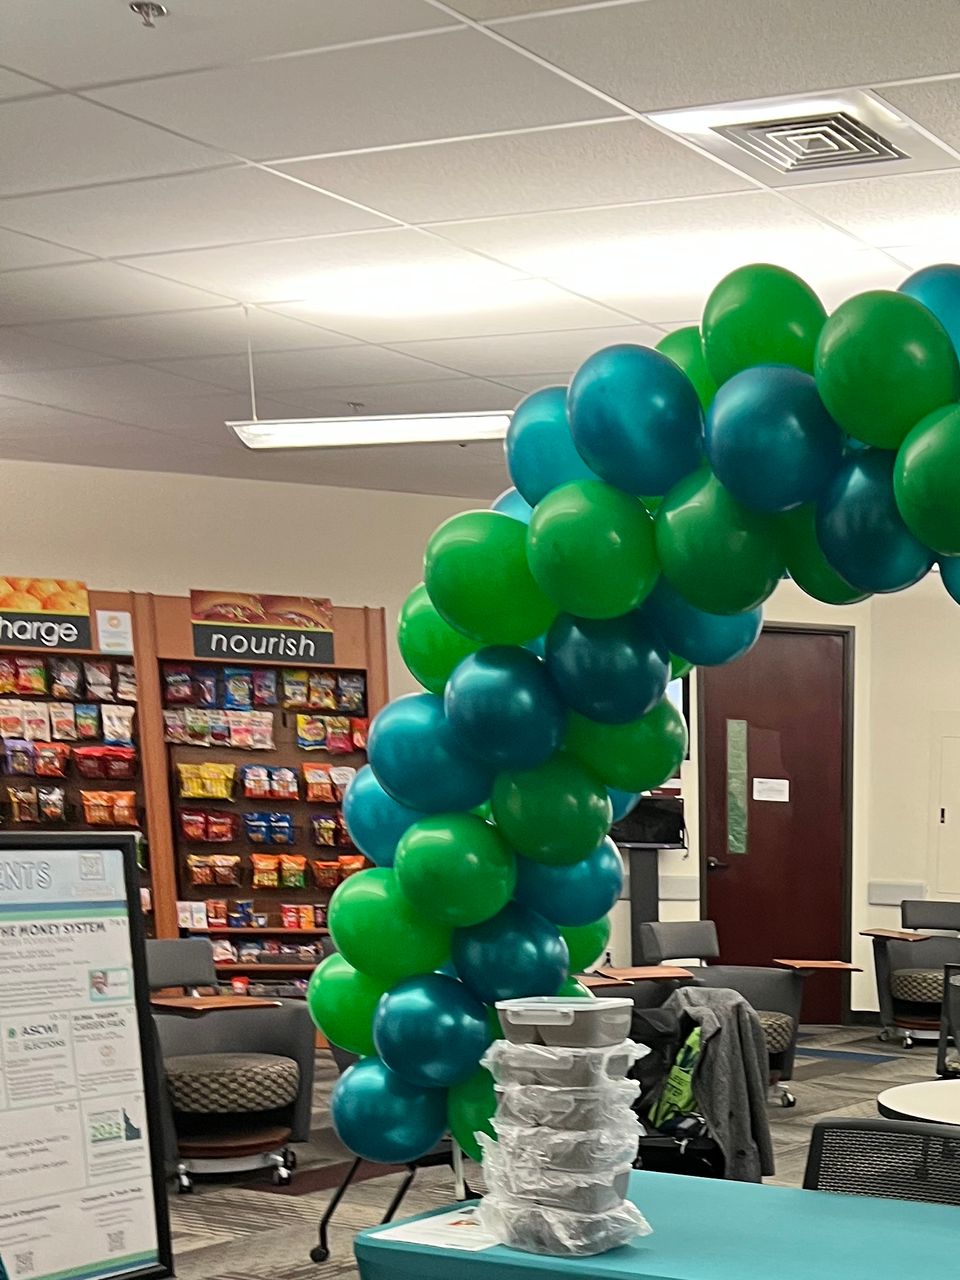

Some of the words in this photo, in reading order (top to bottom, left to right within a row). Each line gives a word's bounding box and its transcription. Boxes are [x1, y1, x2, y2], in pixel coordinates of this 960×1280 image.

[209, 632, 316, 658] nourish
[19, 923, 60, 937] MONEY
[62, 921, 107, 935] SYSTEM
